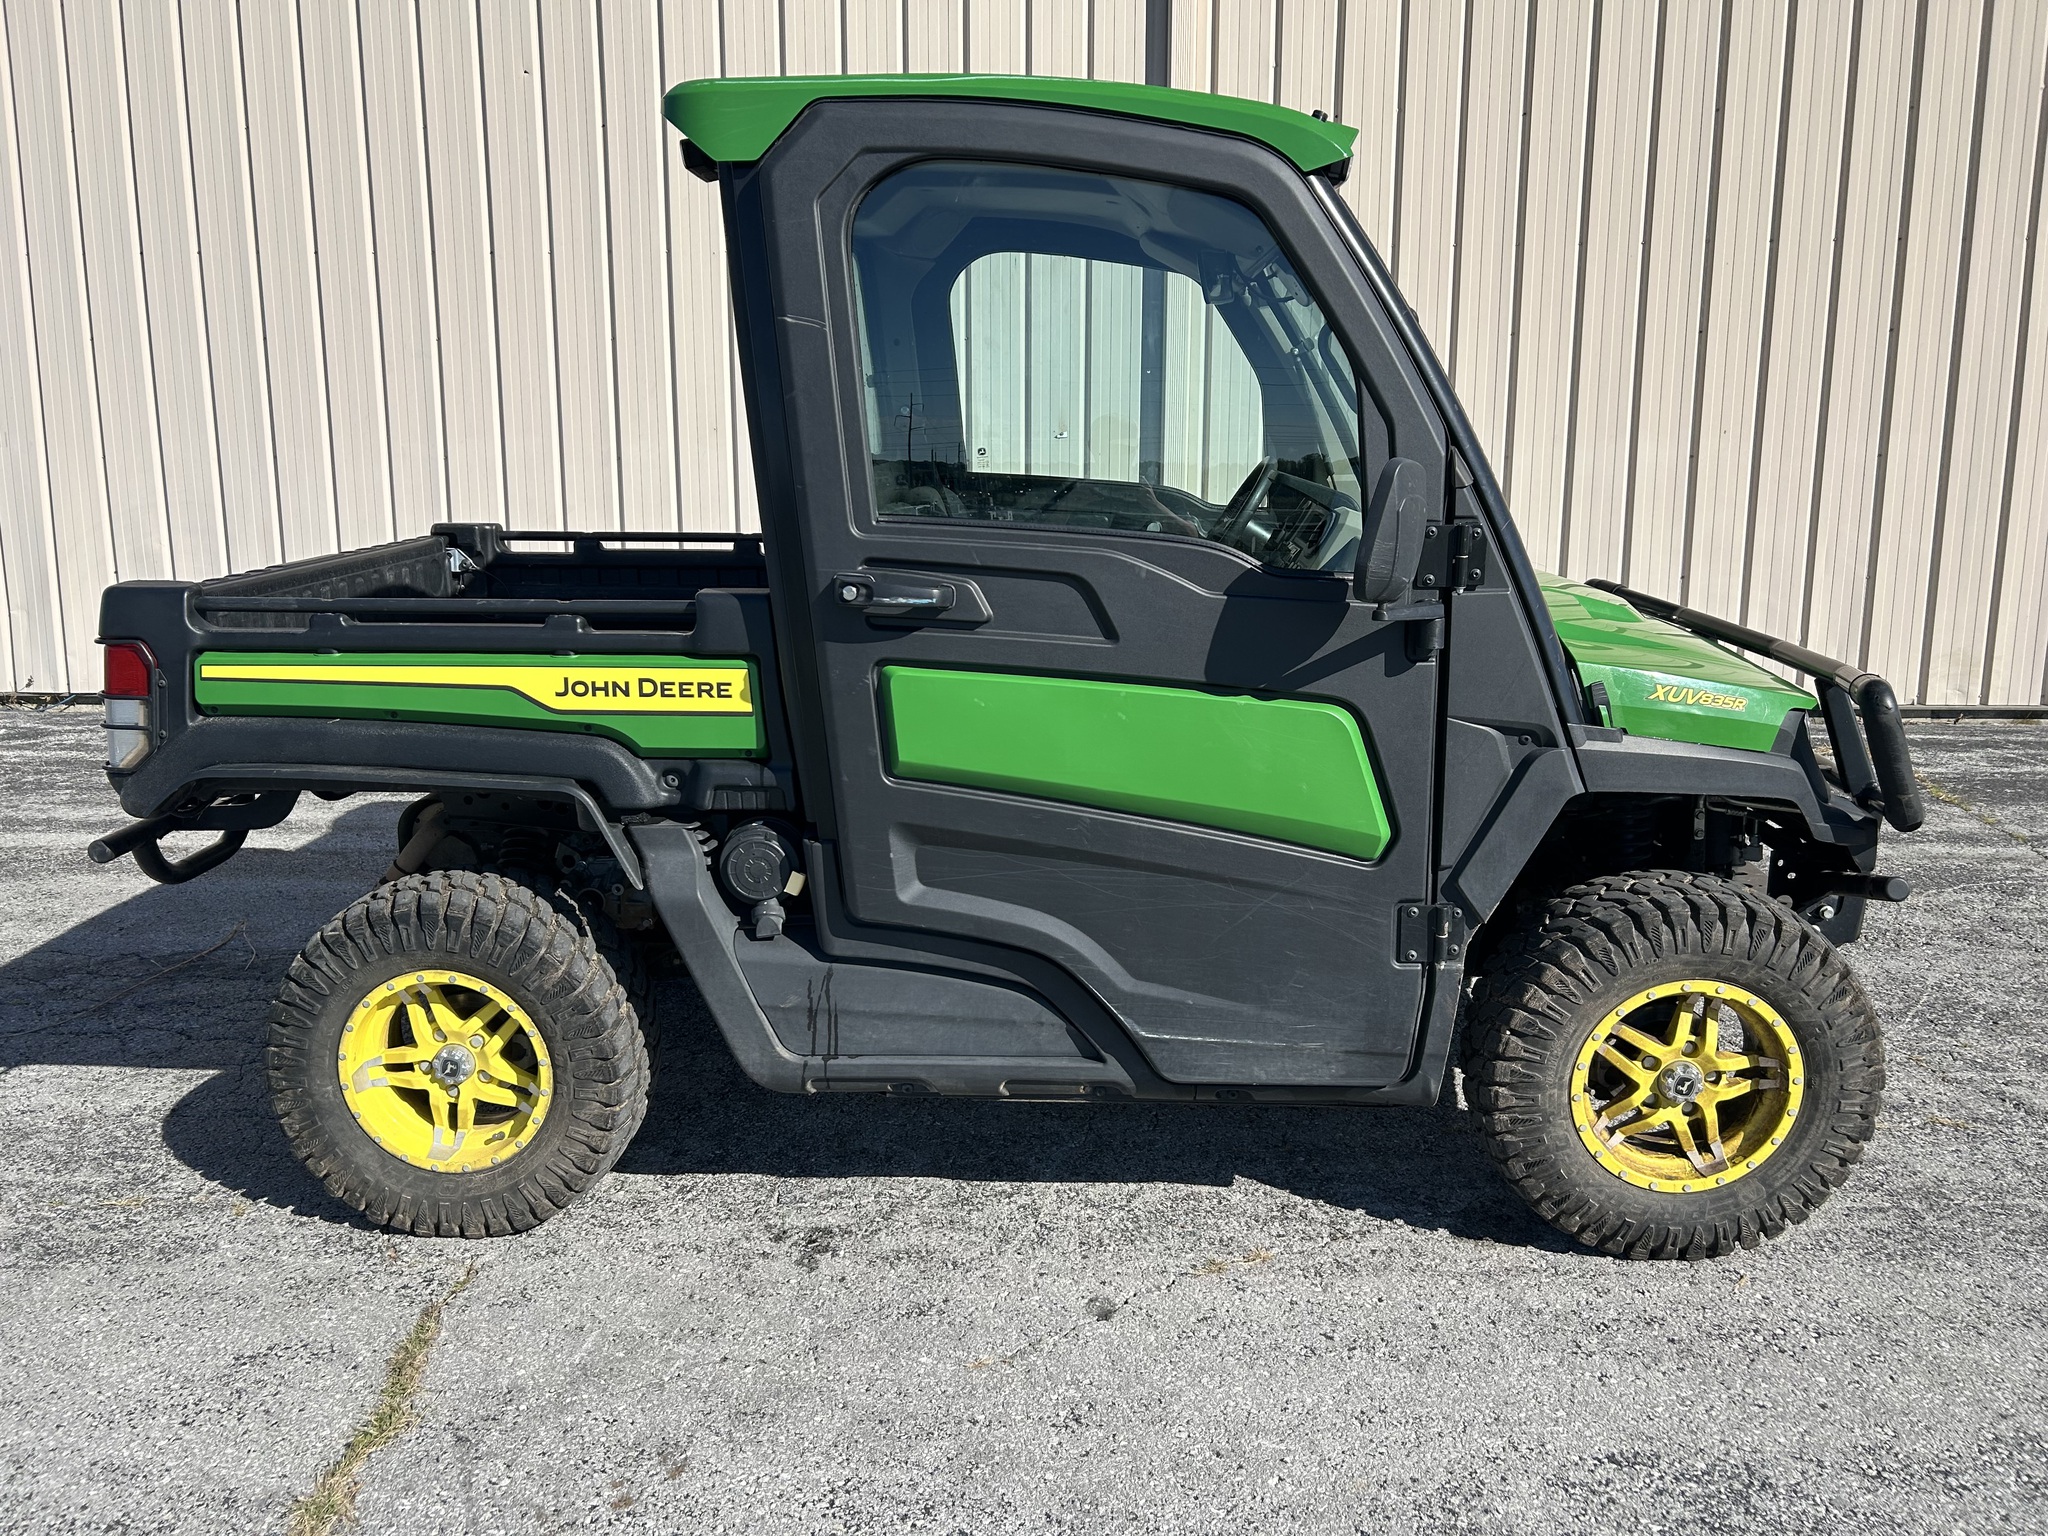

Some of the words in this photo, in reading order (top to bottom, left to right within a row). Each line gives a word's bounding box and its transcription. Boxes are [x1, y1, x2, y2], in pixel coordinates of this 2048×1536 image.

[555, 677, 630, 697] JOHN
[638, 677, 733, 698] DEERE
[1646, 683, 1747, 710] XUV835R
